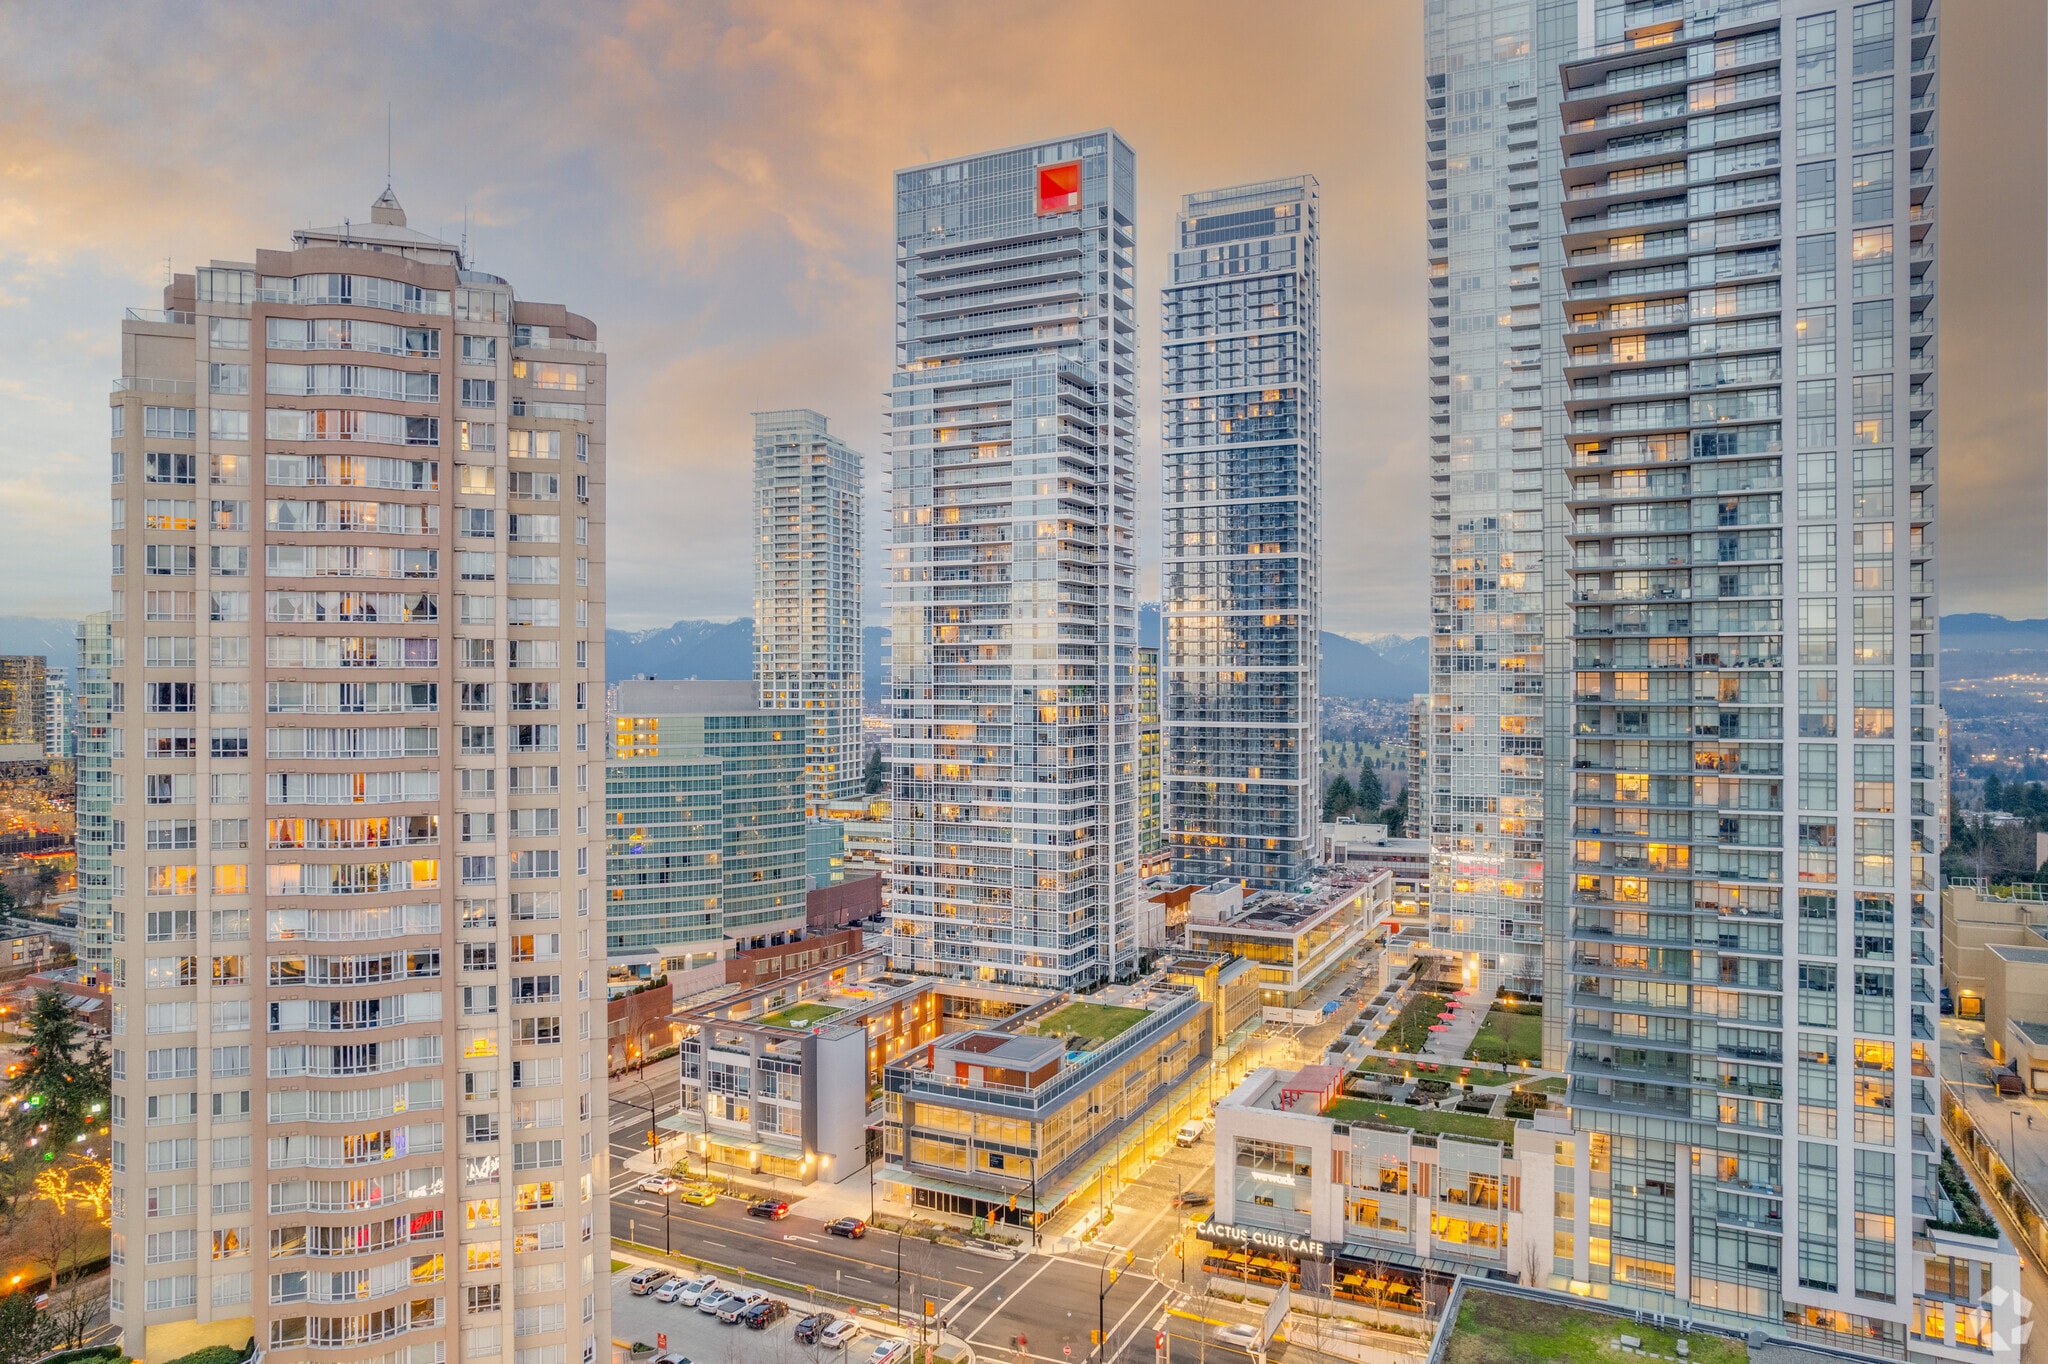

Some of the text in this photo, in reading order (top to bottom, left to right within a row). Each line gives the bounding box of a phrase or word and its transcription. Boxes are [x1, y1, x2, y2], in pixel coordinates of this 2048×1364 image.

[1197, 1222, 1324, 1256] CACTUS CLUB CAFE
